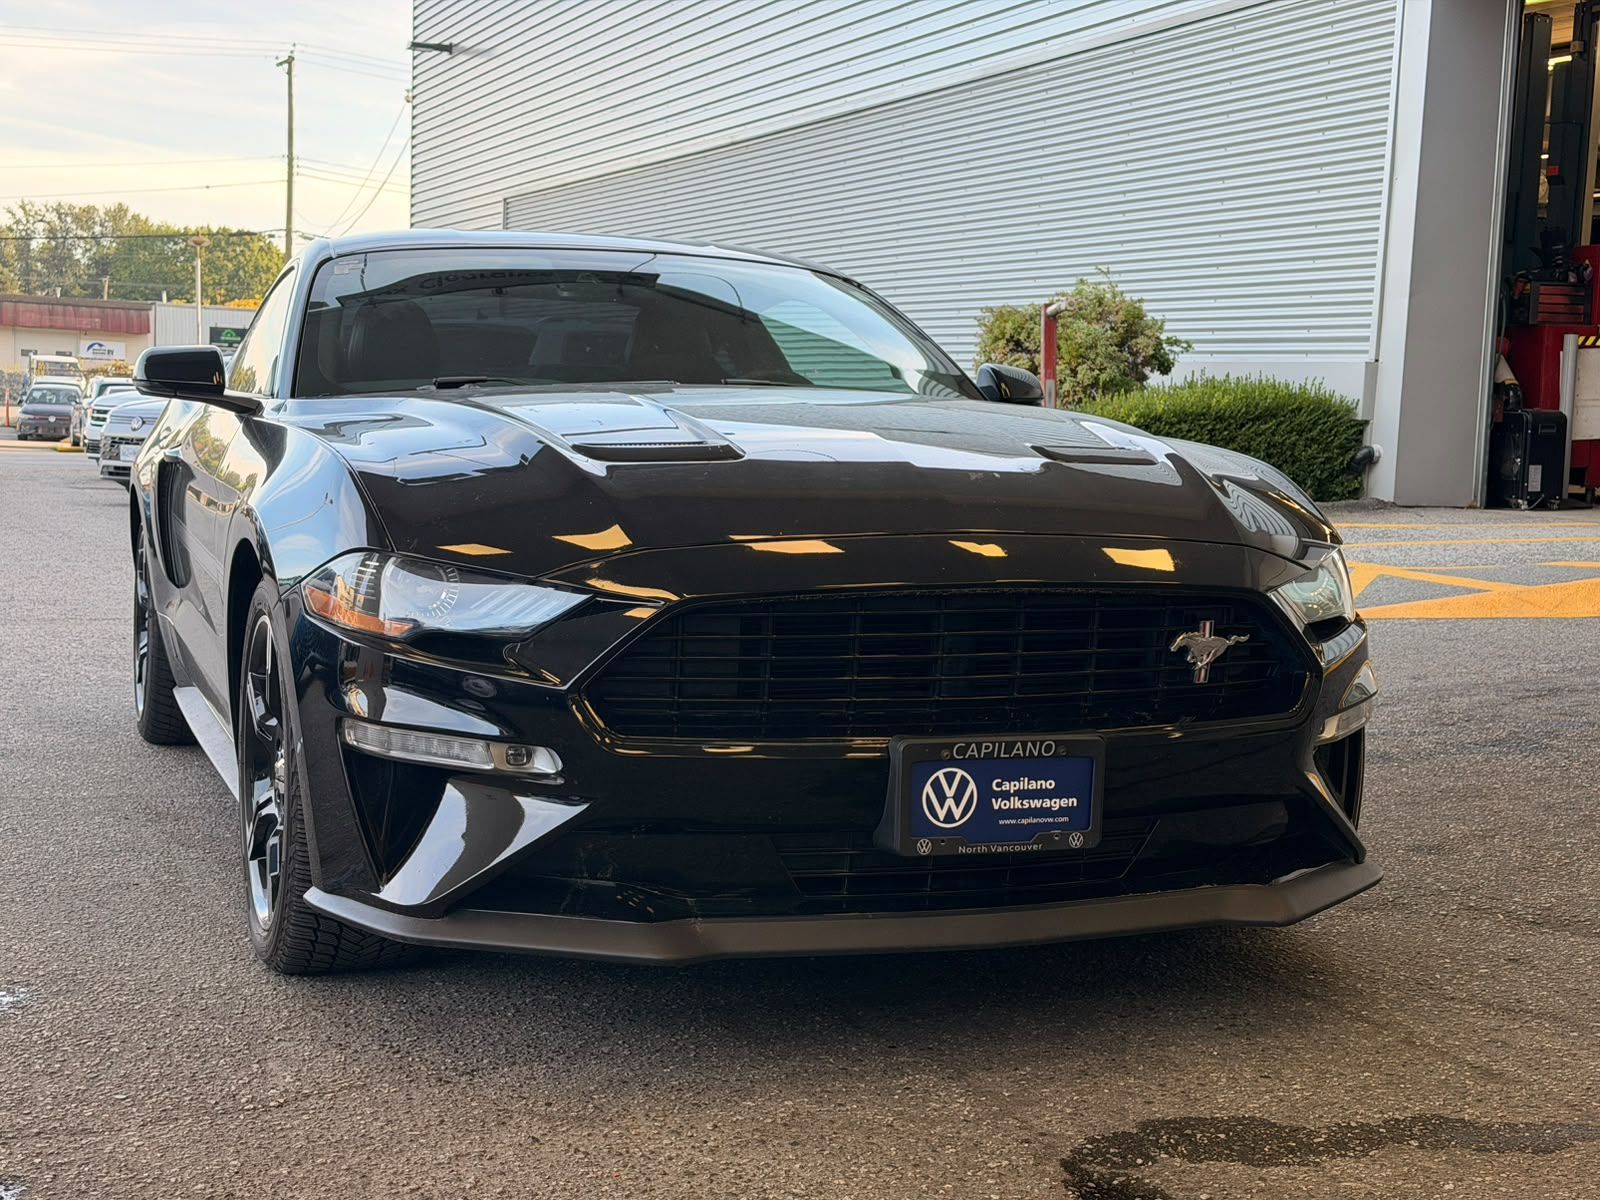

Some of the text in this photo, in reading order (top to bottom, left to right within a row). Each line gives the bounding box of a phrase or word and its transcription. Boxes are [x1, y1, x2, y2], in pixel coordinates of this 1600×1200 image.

[953, 741, 1056, 759] CAPILANO
[992, 777, 1056, 794] Capilano
[991, 796, 1078, 811] Volkswagen
[998, 816, 1070, 826] www.capilanovw.com
[958, 843, 1043, 854] North Vancouver
